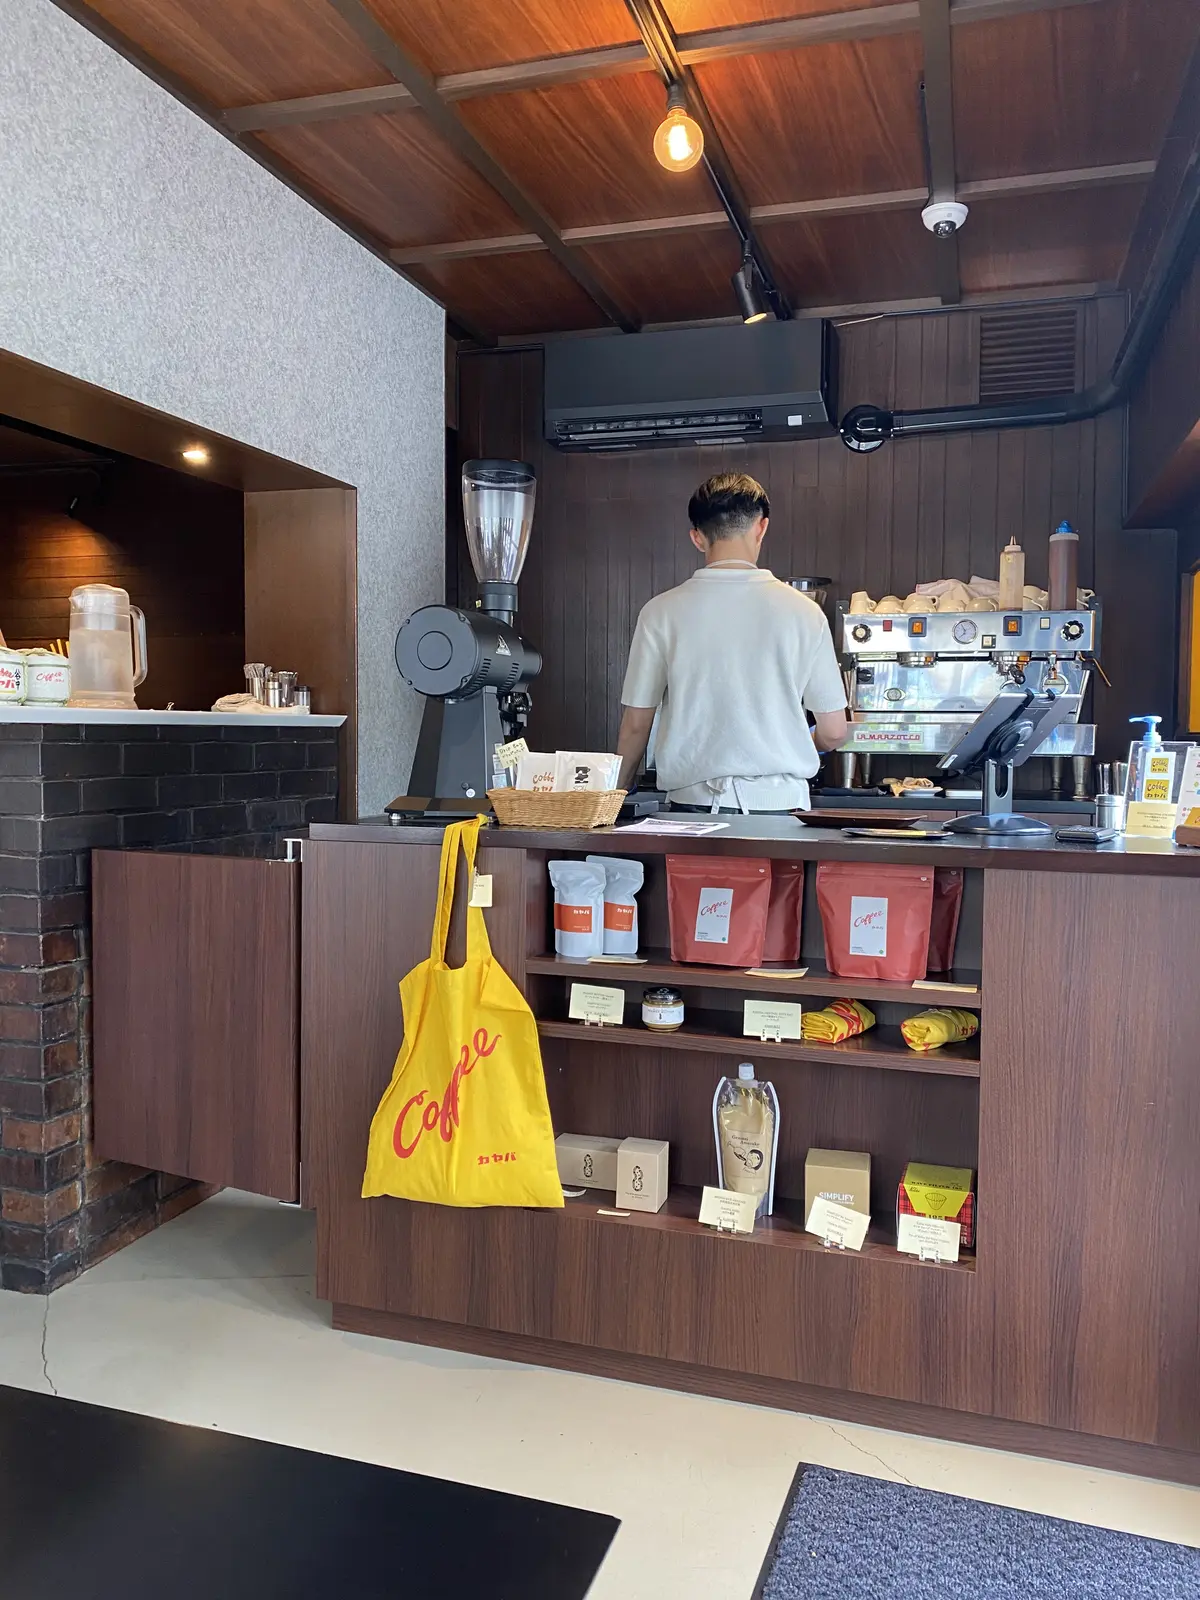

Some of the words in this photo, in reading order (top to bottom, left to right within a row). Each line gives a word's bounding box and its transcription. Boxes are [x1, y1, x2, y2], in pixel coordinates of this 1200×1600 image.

[701, 900, 729, 916] Coffee
[854, 910, 884, 927] Coffee
[392, 1027, 502, 1158] Coffee
[477, 1151, 517, 1165] カヤバ
[819, 1191, 854, 1202] SIMPLIFY
